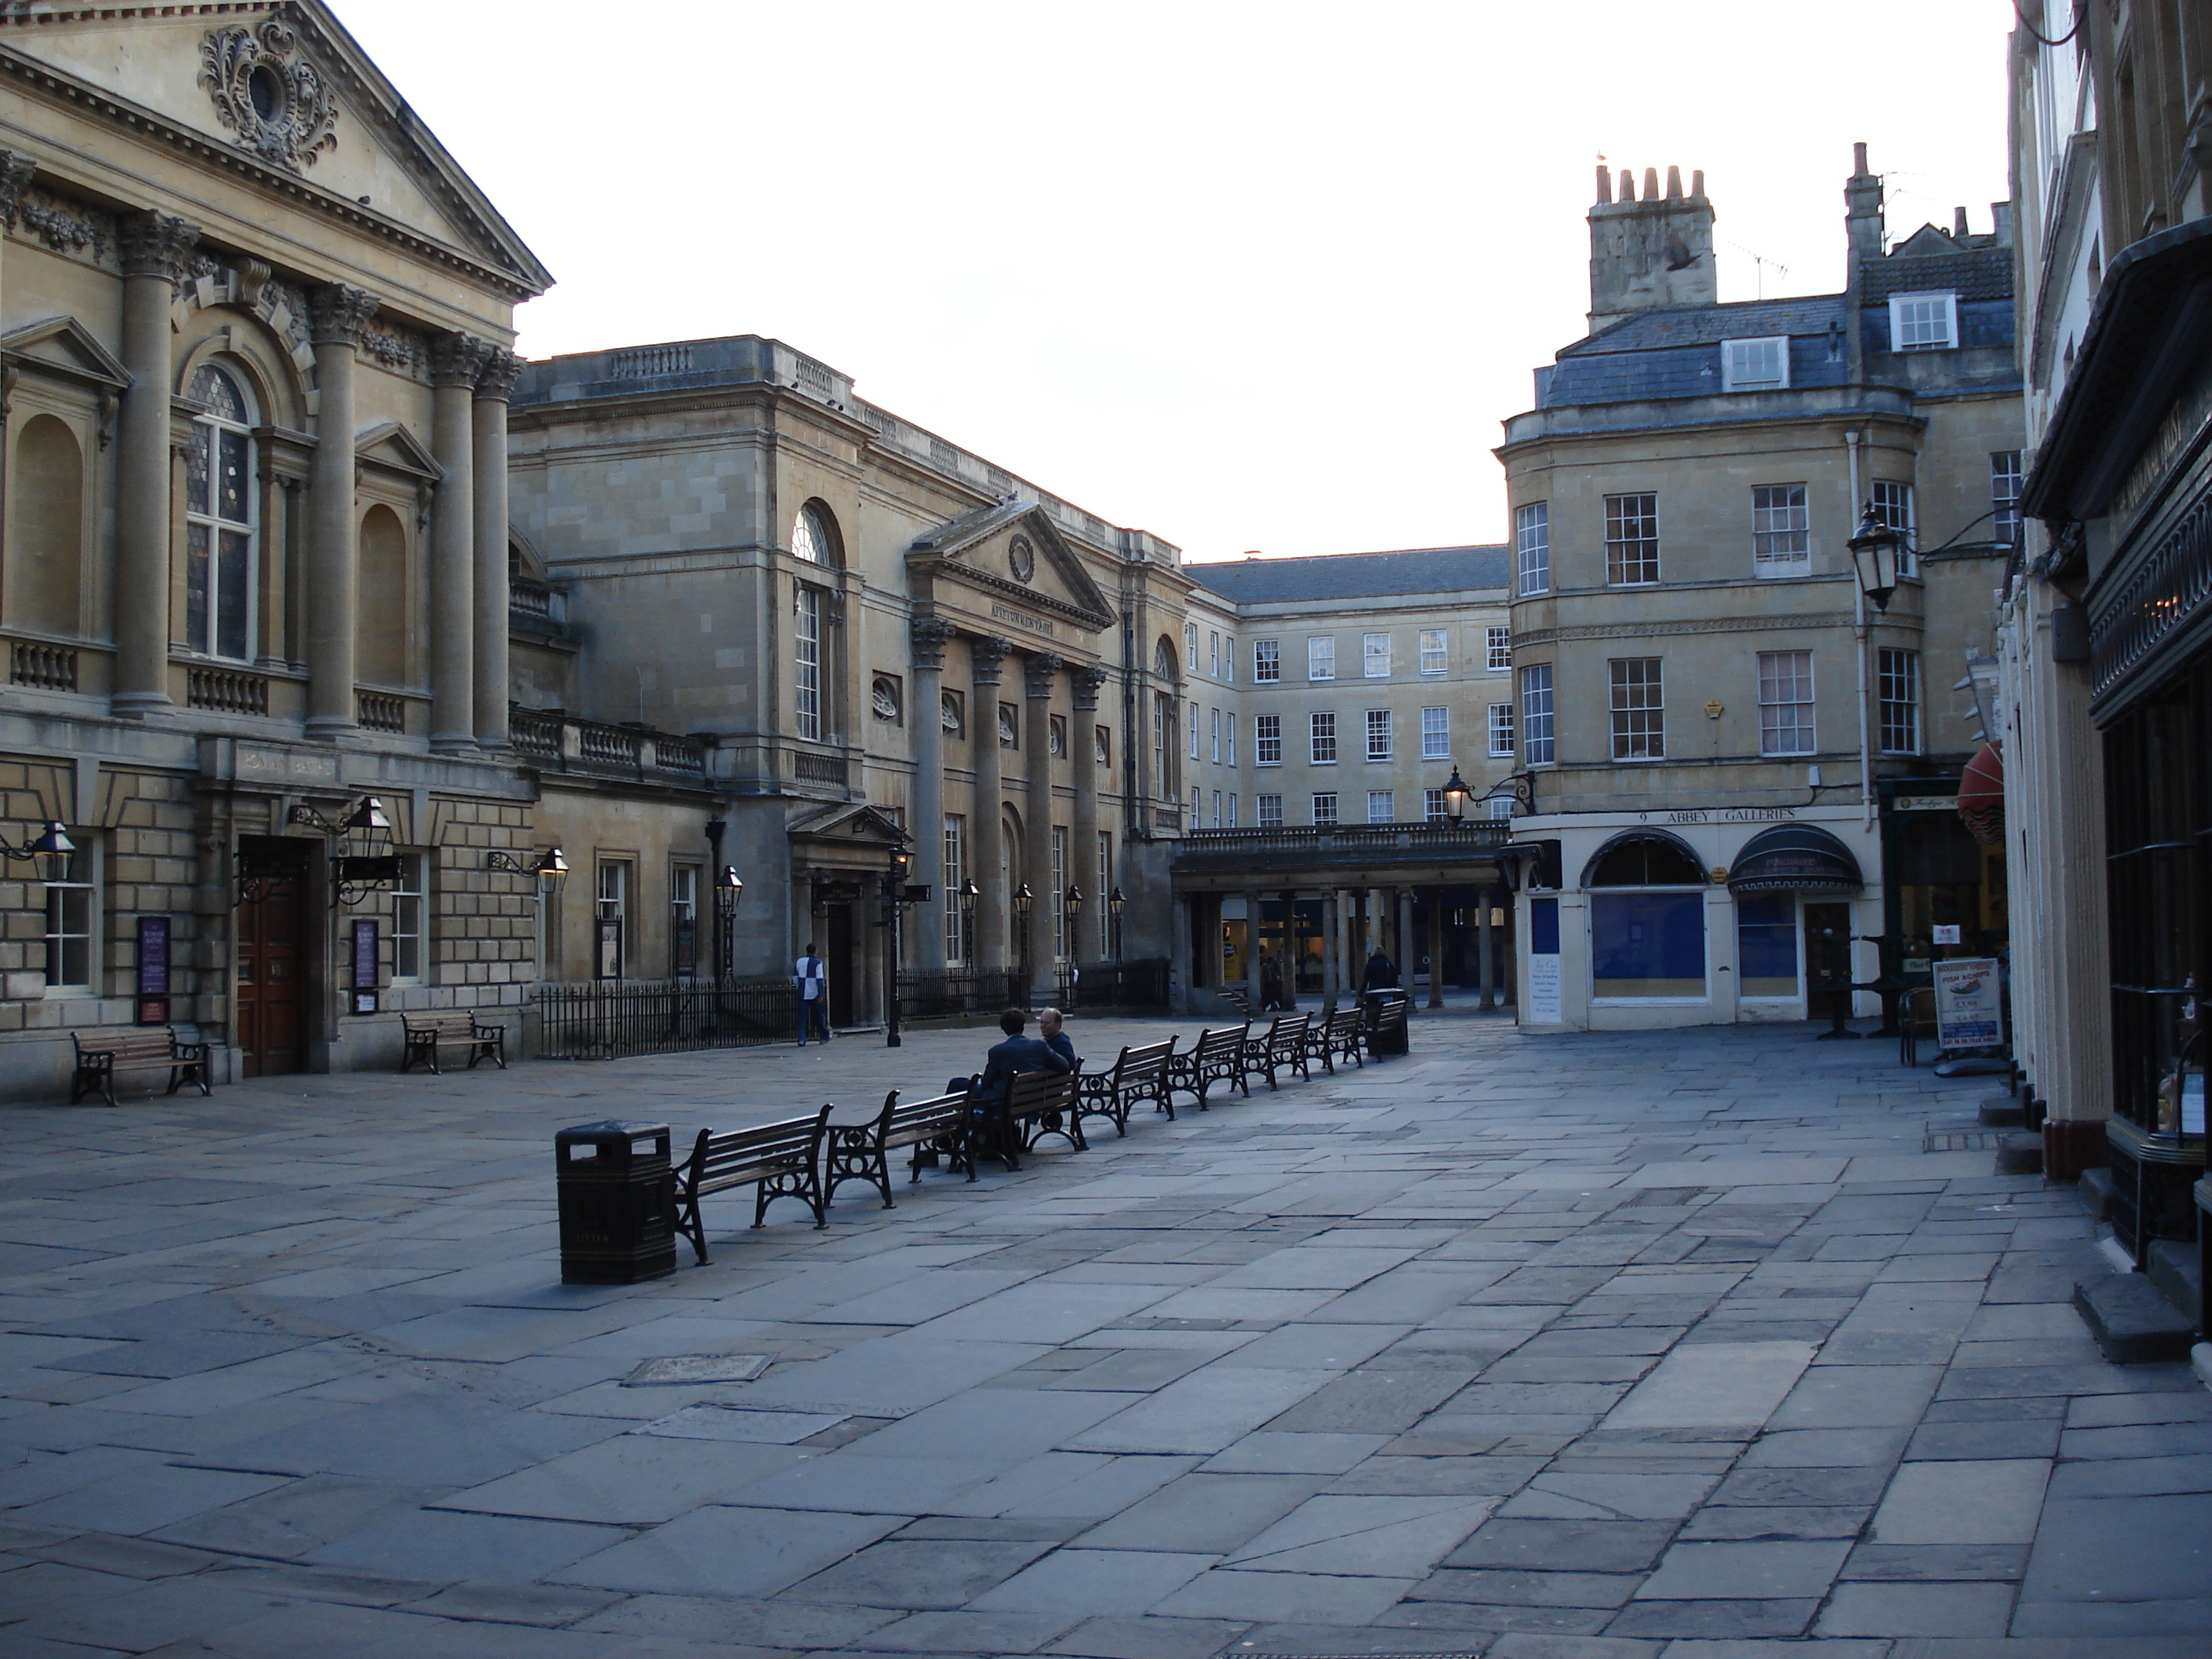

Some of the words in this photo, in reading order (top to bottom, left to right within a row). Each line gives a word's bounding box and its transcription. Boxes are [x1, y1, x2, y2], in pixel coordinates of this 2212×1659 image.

[1639, 812, 1647, 823] 9
[1667, 811, 1710, 823] ABBEY
[1725, 808, 1796, 822] GALLERIES
